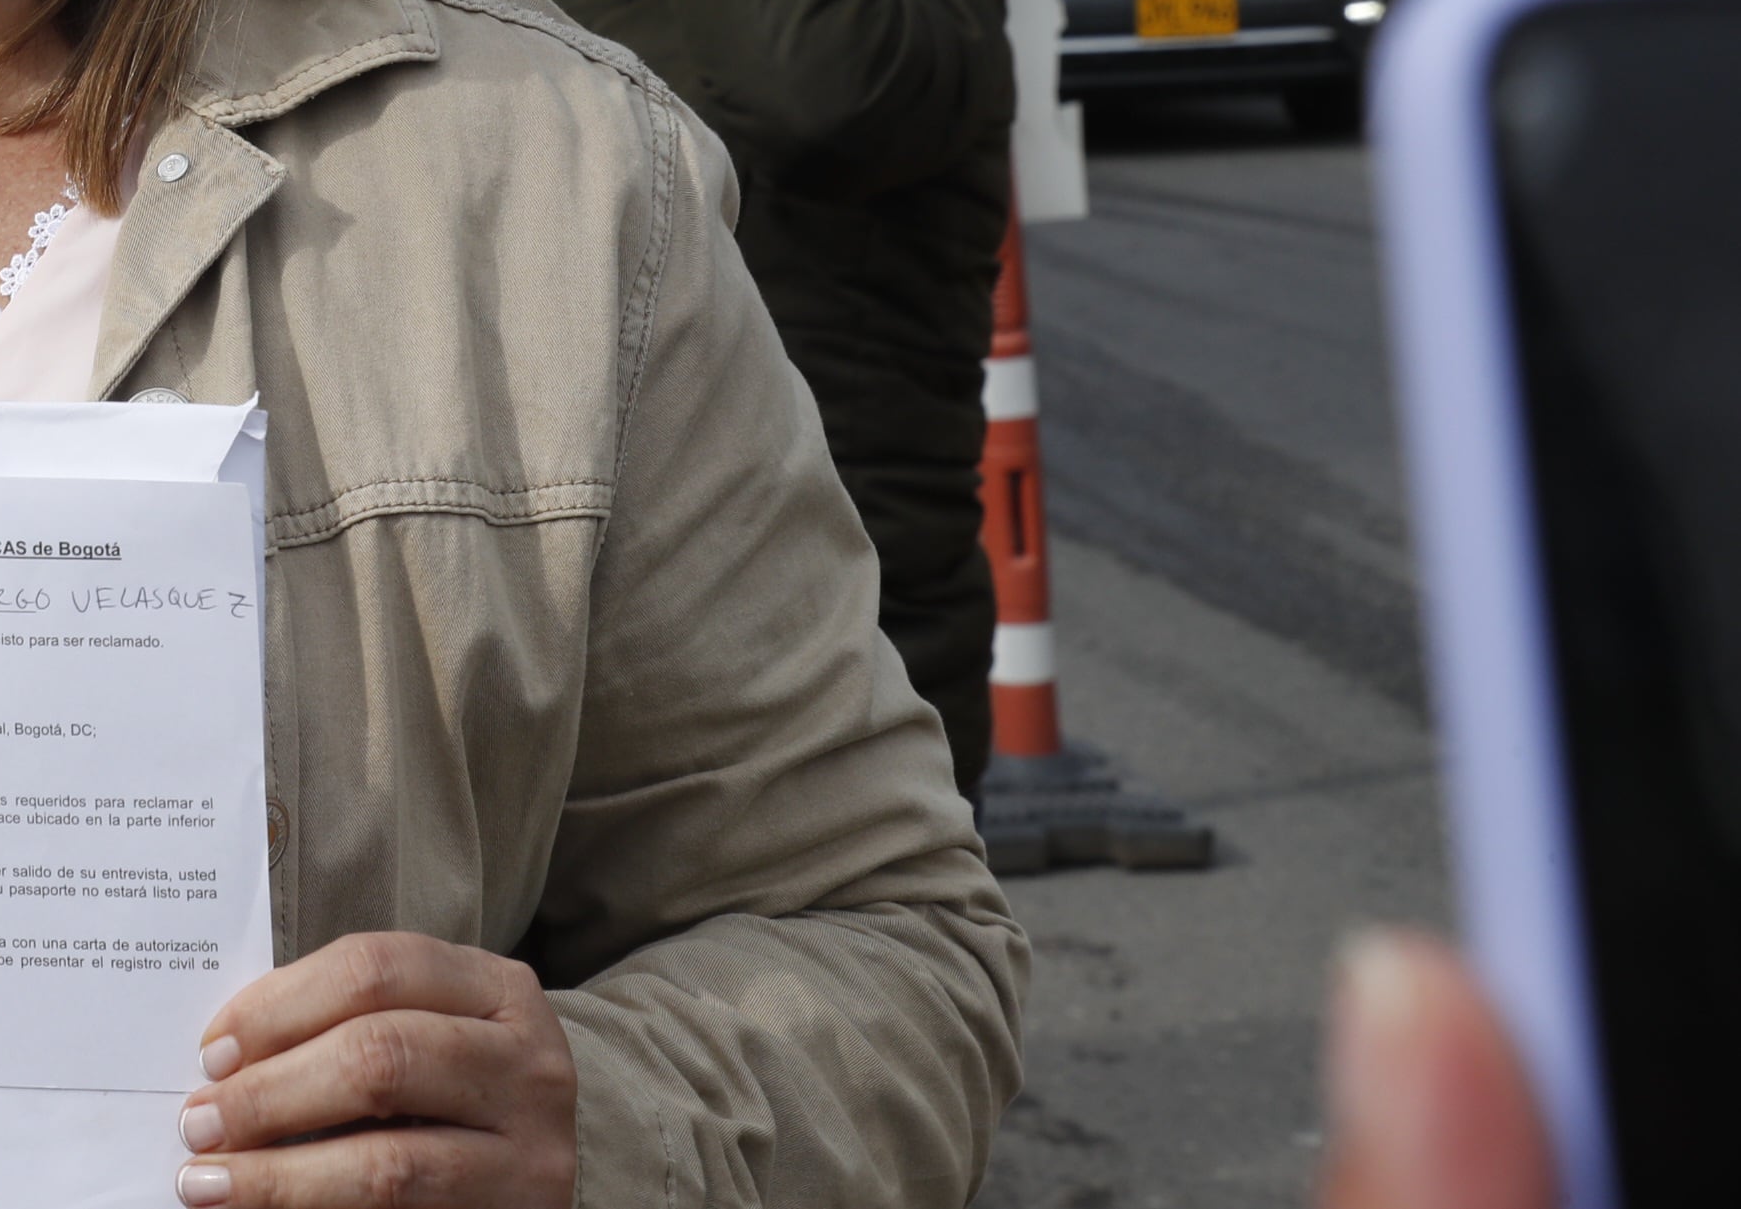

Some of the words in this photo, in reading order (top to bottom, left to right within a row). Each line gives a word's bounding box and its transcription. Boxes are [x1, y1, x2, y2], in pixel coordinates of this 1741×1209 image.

[32, 539, 53, 555] de
[58, 540, 120, 560] Bogotá
[28, 635, 59, 649] para
[62, 635, 84, 647] ser
[88, 632, 163, 648] reclamado.
[14, 721, 66, 740] Bogotá,
[70, 723, 96, 739] DC;
[15, 792, 86, 811] requeridos
[94, 797, 125, 812] para
[133, 794, 193, 810] reclamar
[200, 796, 213, 811] el
[26, 810, 80, 825] ubicado
[85, 814, 102, 826] en
[108, 811, 120, 826] la
[126, 812, 162, 830] parte
[167, 812, 215, 828] inferior
[12, 863, 52, 879] salido
[56, 864, 74, 879] de
[79, 868, 96, 880] su
[101, 866, 172, 883] entrevista,
[178, 867, 216, 883] usted
[8, 882, 76, 900] pasaporte
[82, 886, 99, 898] no
[104, 884, 146, 899] estará
[152, 884, 180, 900] listo
[186, 889, 217, 904] para
[11, 938, 36, 949] con
[42, 938, 67, 950] una
[72, 937, 106, 951] carta
[112, 936, 130, 952] de
[134, 937, 218, 954] autorización
